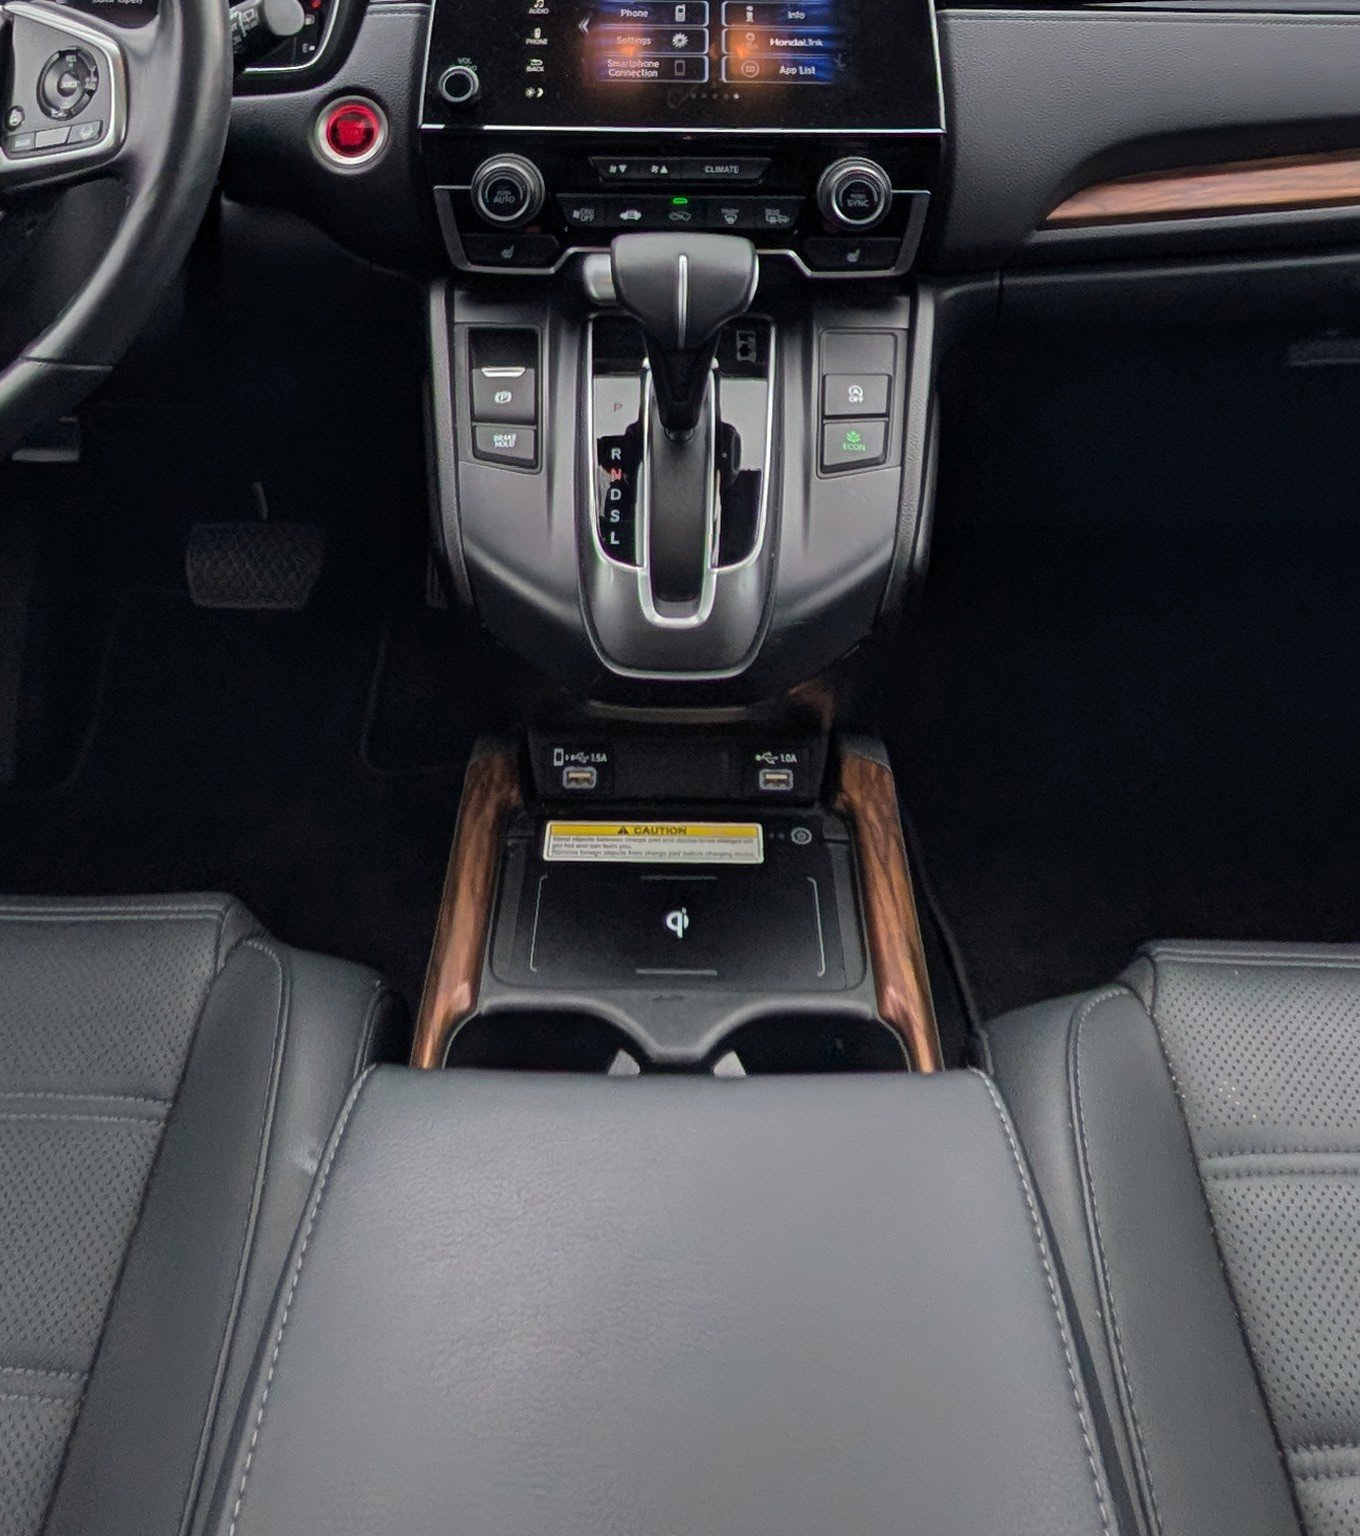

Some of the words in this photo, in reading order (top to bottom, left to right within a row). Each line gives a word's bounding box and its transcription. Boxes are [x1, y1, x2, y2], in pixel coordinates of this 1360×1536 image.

[620, 8, 649, 18] Phone
[617, 35, 652, 46] Settings
[769, 37, 823, 47] HondaLink
[608, 67, 658, 78] Connection
[611, 447, 622, 460] R
[610, 488, 621, 501] D
[609, 509, 620, 523] S
[609, 531, 620, 545] L
[633, 825, 687, 836] CAUTION
